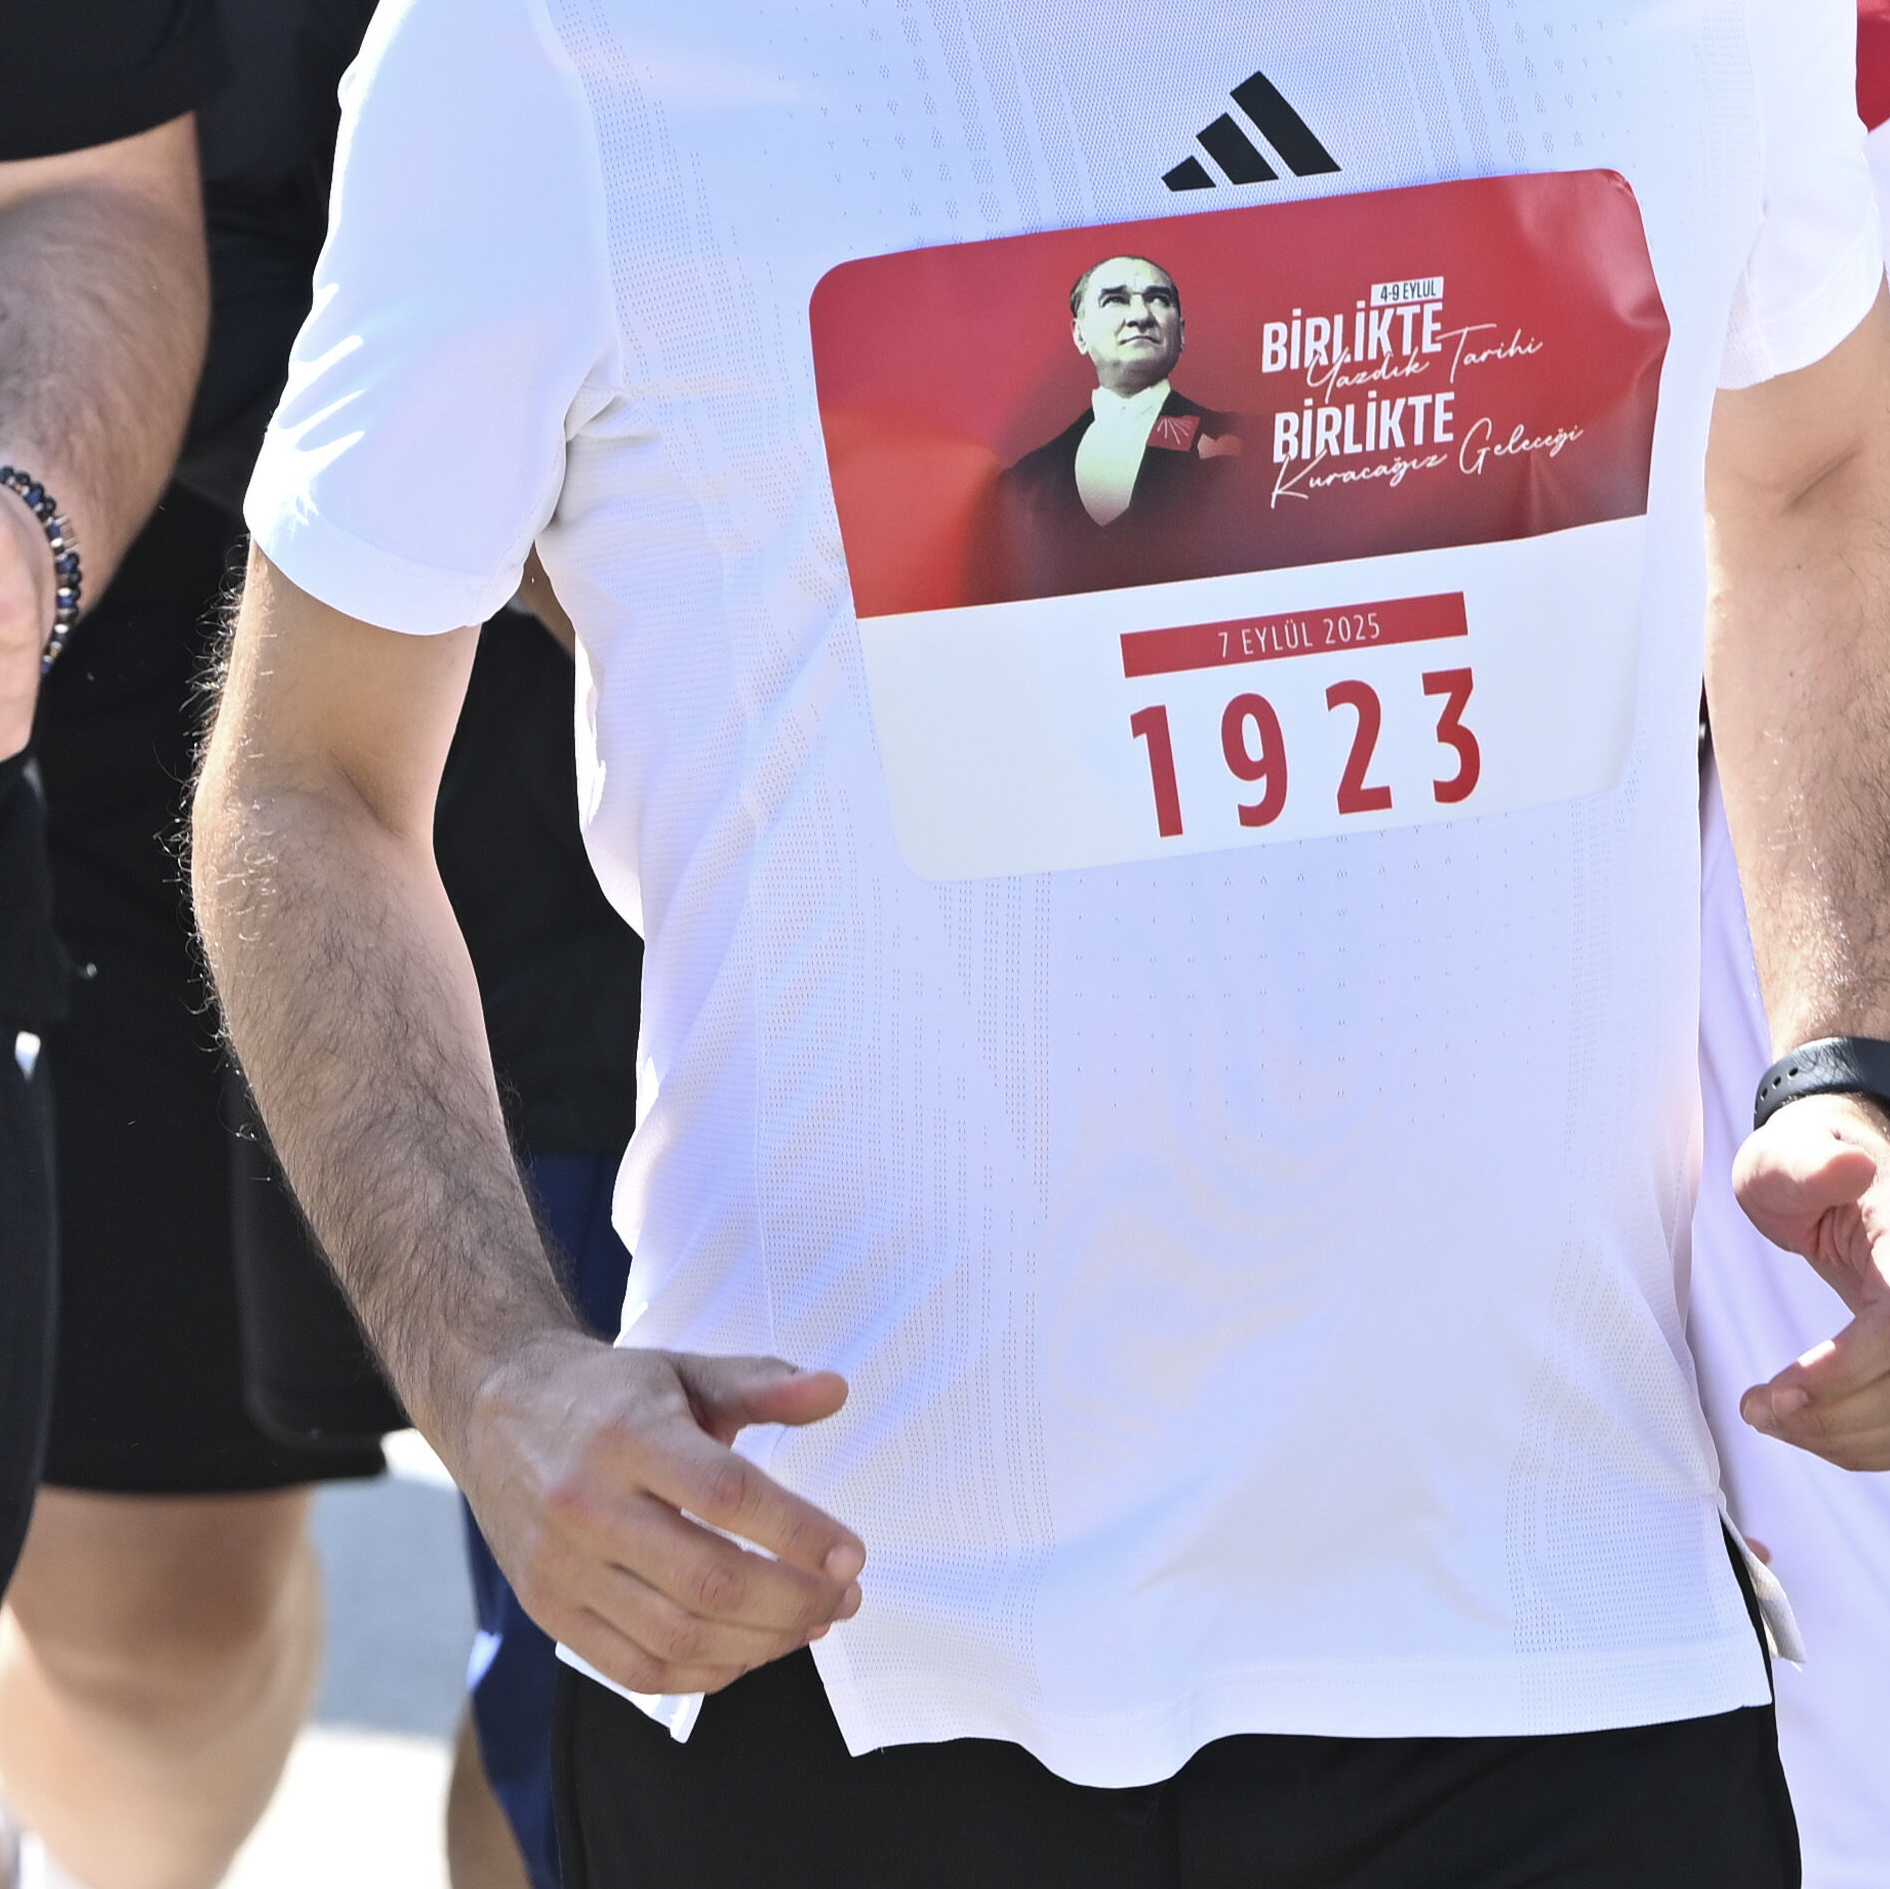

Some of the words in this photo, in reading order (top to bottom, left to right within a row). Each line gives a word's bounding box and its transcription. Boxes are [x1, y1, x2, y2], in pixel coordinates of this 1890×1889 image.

[1380, 284, 1400, 302] 4-9
[1262, 300, 1444, 373] BİRLİKTE
[1306, 346, 1430, 404] Yazdık
[1435, 323, 1544, 384] Tarihi
[1273, 390, 1456, 463] BİRLİKTE
[1270, 448, 1448, 510] Kuracağız
[1459, 417, 1585, 475] Geleceği
[1217, 631, 1230, 659] 7
[1241, 618, 1314, 656] EYLÜL
[1323, 611, 1382, 646] 2025
[1129, 666, 1482, 839] 1923
